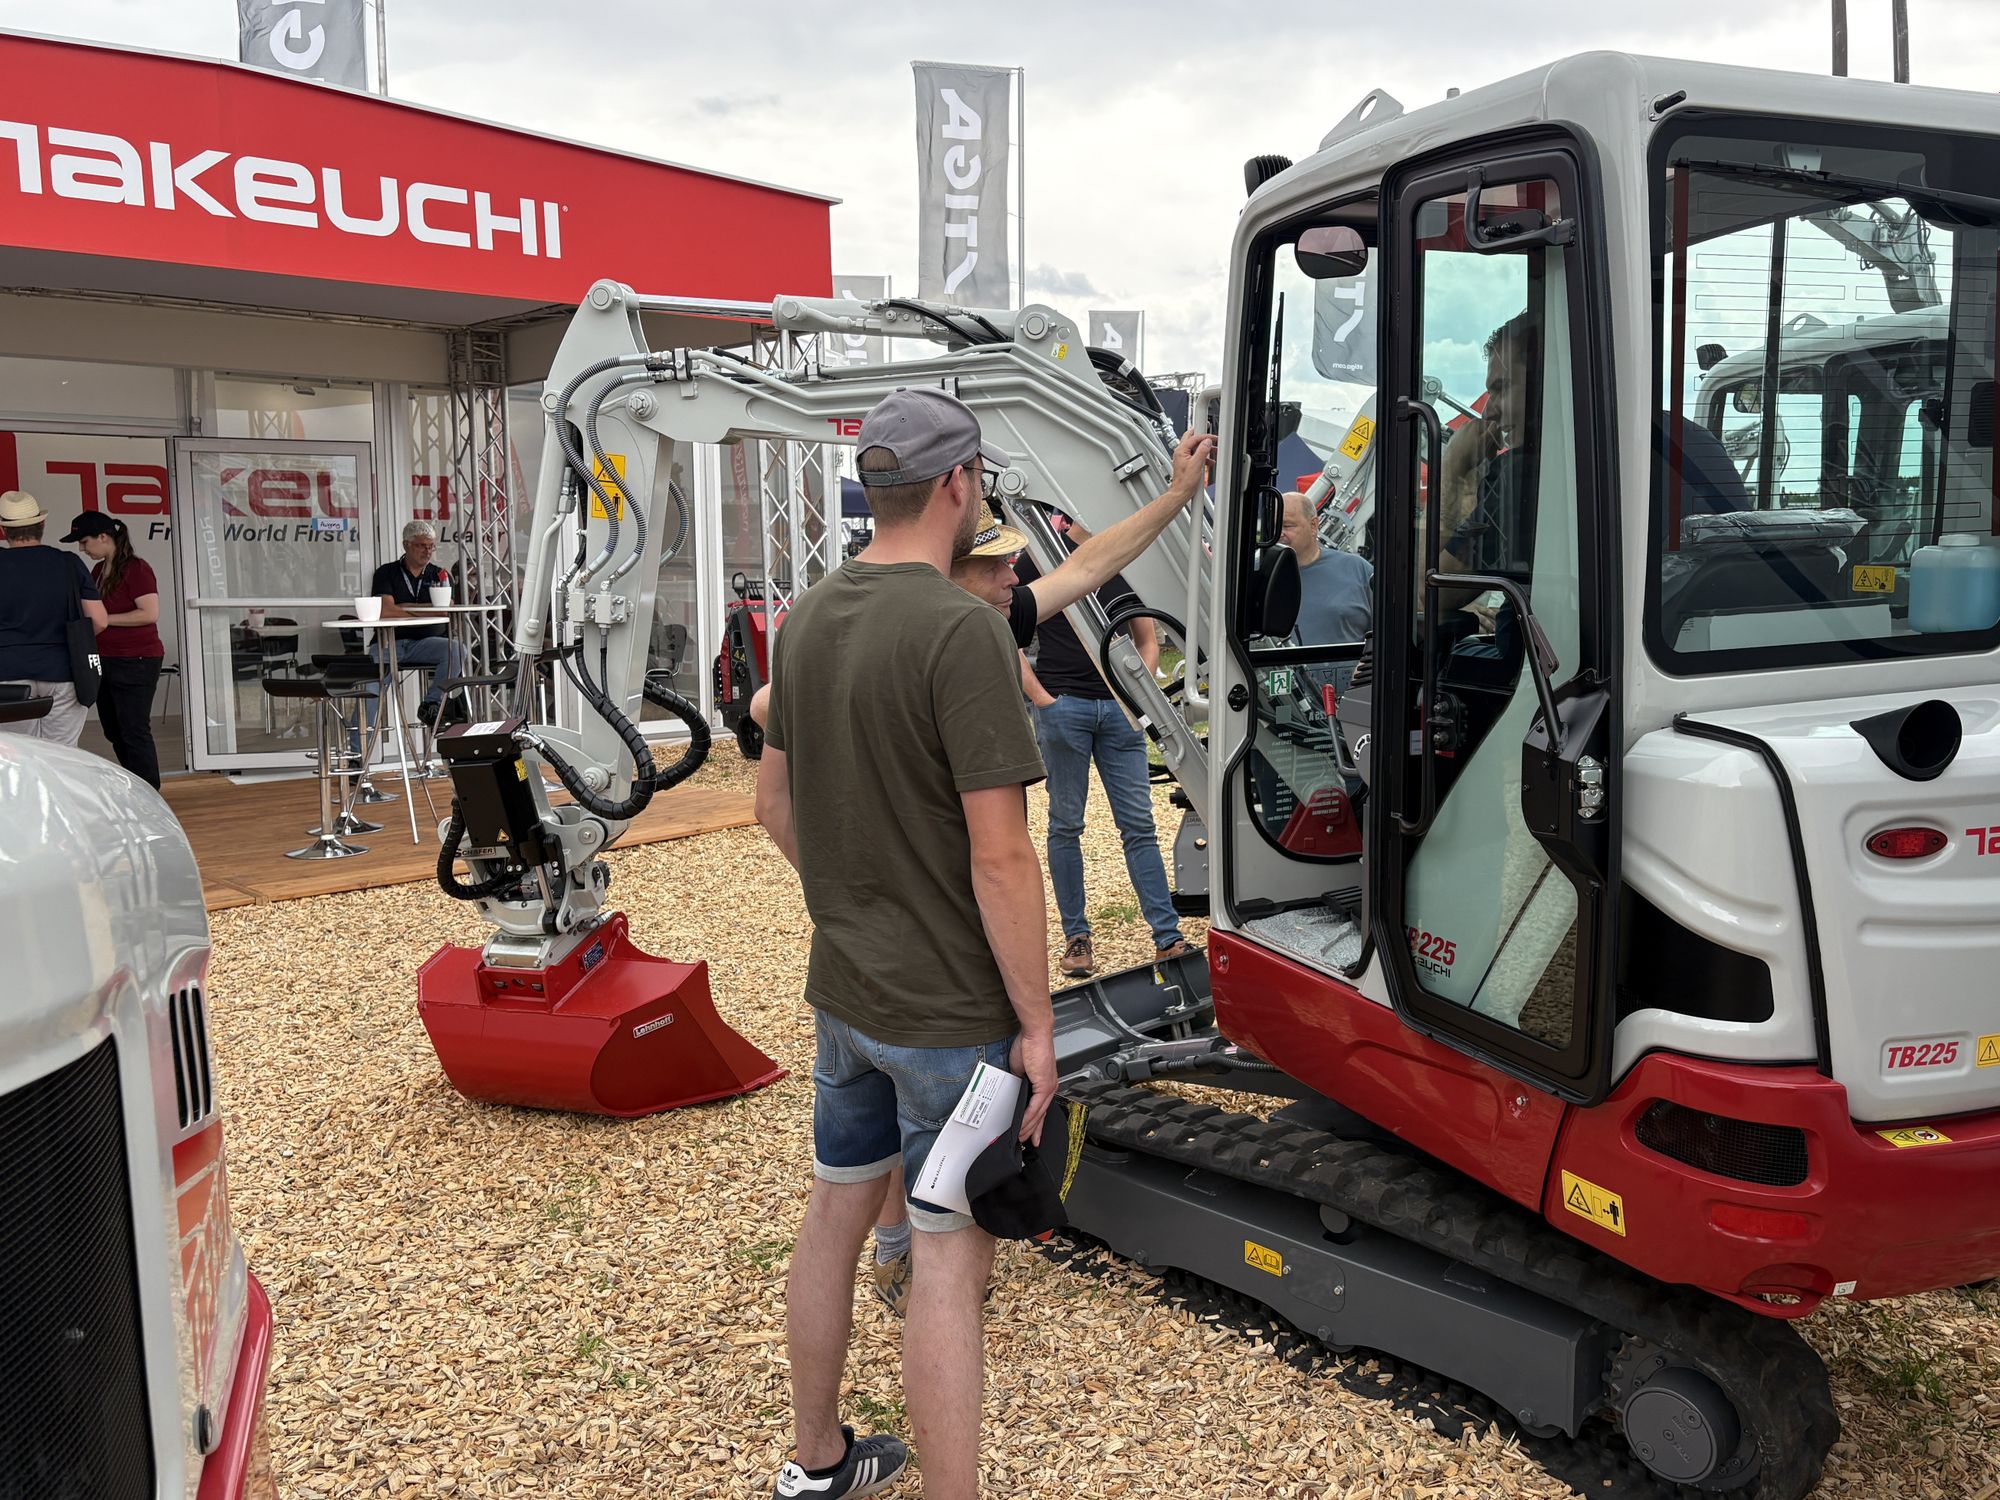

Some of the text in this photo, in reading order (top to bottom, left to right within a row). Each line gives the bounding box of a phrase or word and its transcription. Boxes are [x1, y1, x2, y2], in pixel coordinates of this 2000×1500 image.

[224, 522, 288, 542] World
[1408, 927, 1457, 966] B225
[635, 1016, 672, 1036] Lehnhoff
[1887, 1041, 1959, 1069] TB225
[779, 1480, 795, 1491] adidas
